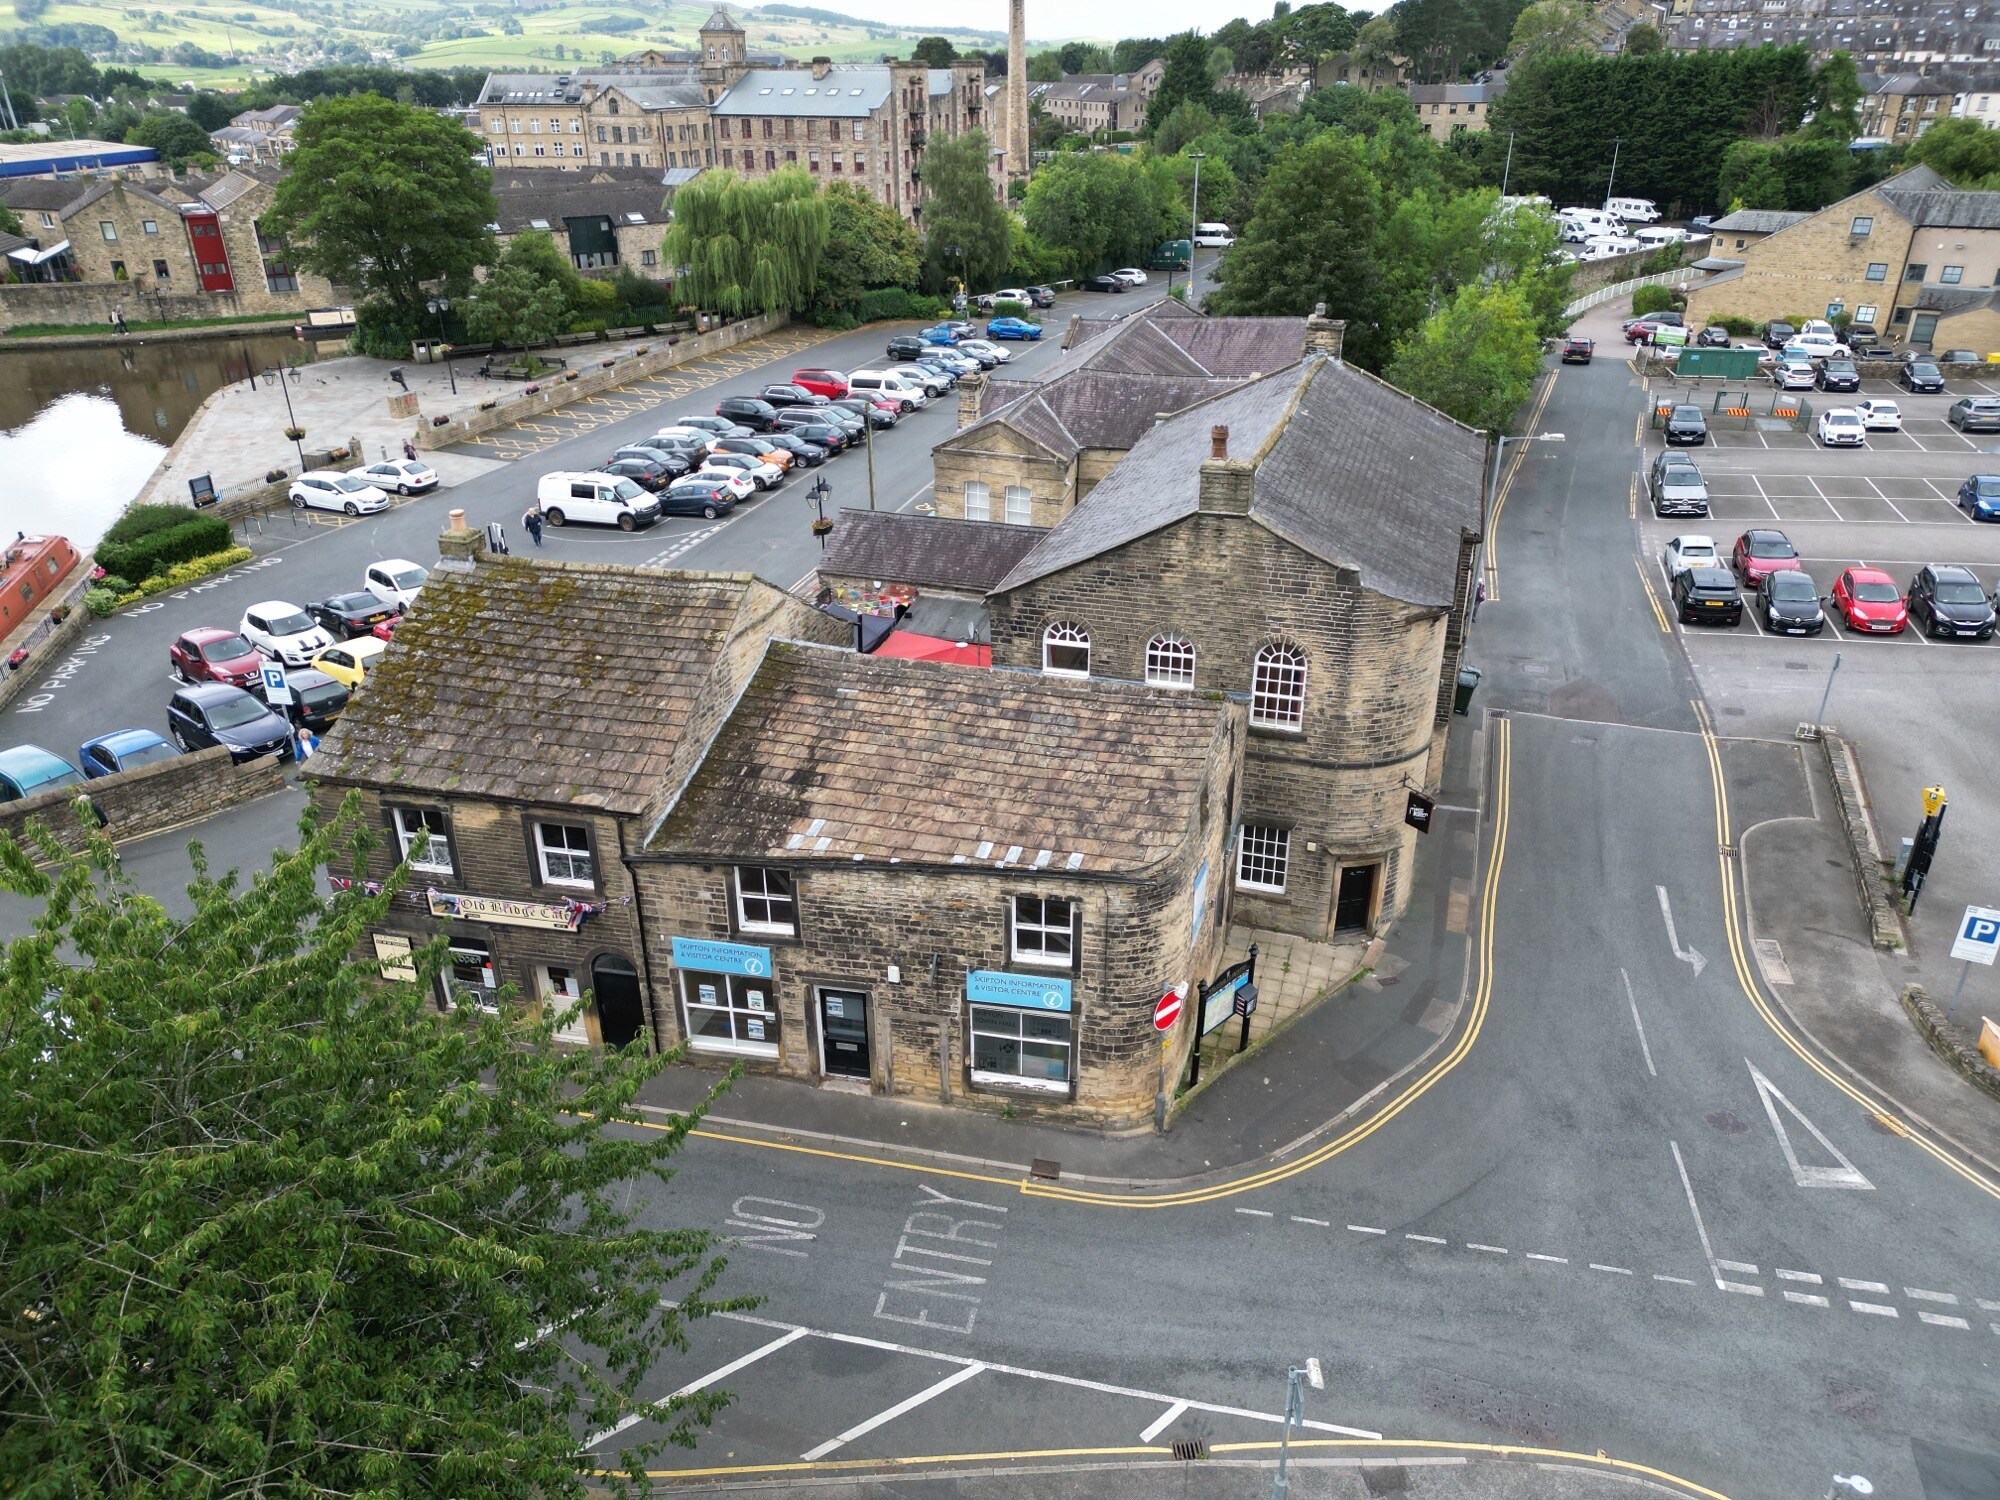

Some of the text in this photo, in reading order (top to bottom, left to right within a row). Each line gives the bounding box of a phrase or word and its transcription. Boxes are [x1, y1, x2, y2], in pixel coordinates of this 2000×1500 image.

[121, 557, 283, 618] NO PARKING
[15, 634, 112, 713] NO PARKING
[269, 671, 281, 687] P
[461, 899, 485, 911] Old
[490, 901, 536, 918] Bridge
[1970, 919, 1996, 939] P
[679, 943, 763, 959] SKIPTON INFORMATION
[687, 952, 712, 960] VISITOR
[714, 955, 742, 964] CENTRE
[974, 976, 1064, 992] SKIPTON INFORMATION
[981, 985, 1009, 994] VISITOR
[1011, 988, 1040, 997] CENTRE
[974, 1009, 1004, 1018] SKIPTON
[724, 1195, 825, 1258] NO
[873, 1184, 1008, 1334] ENTRY
